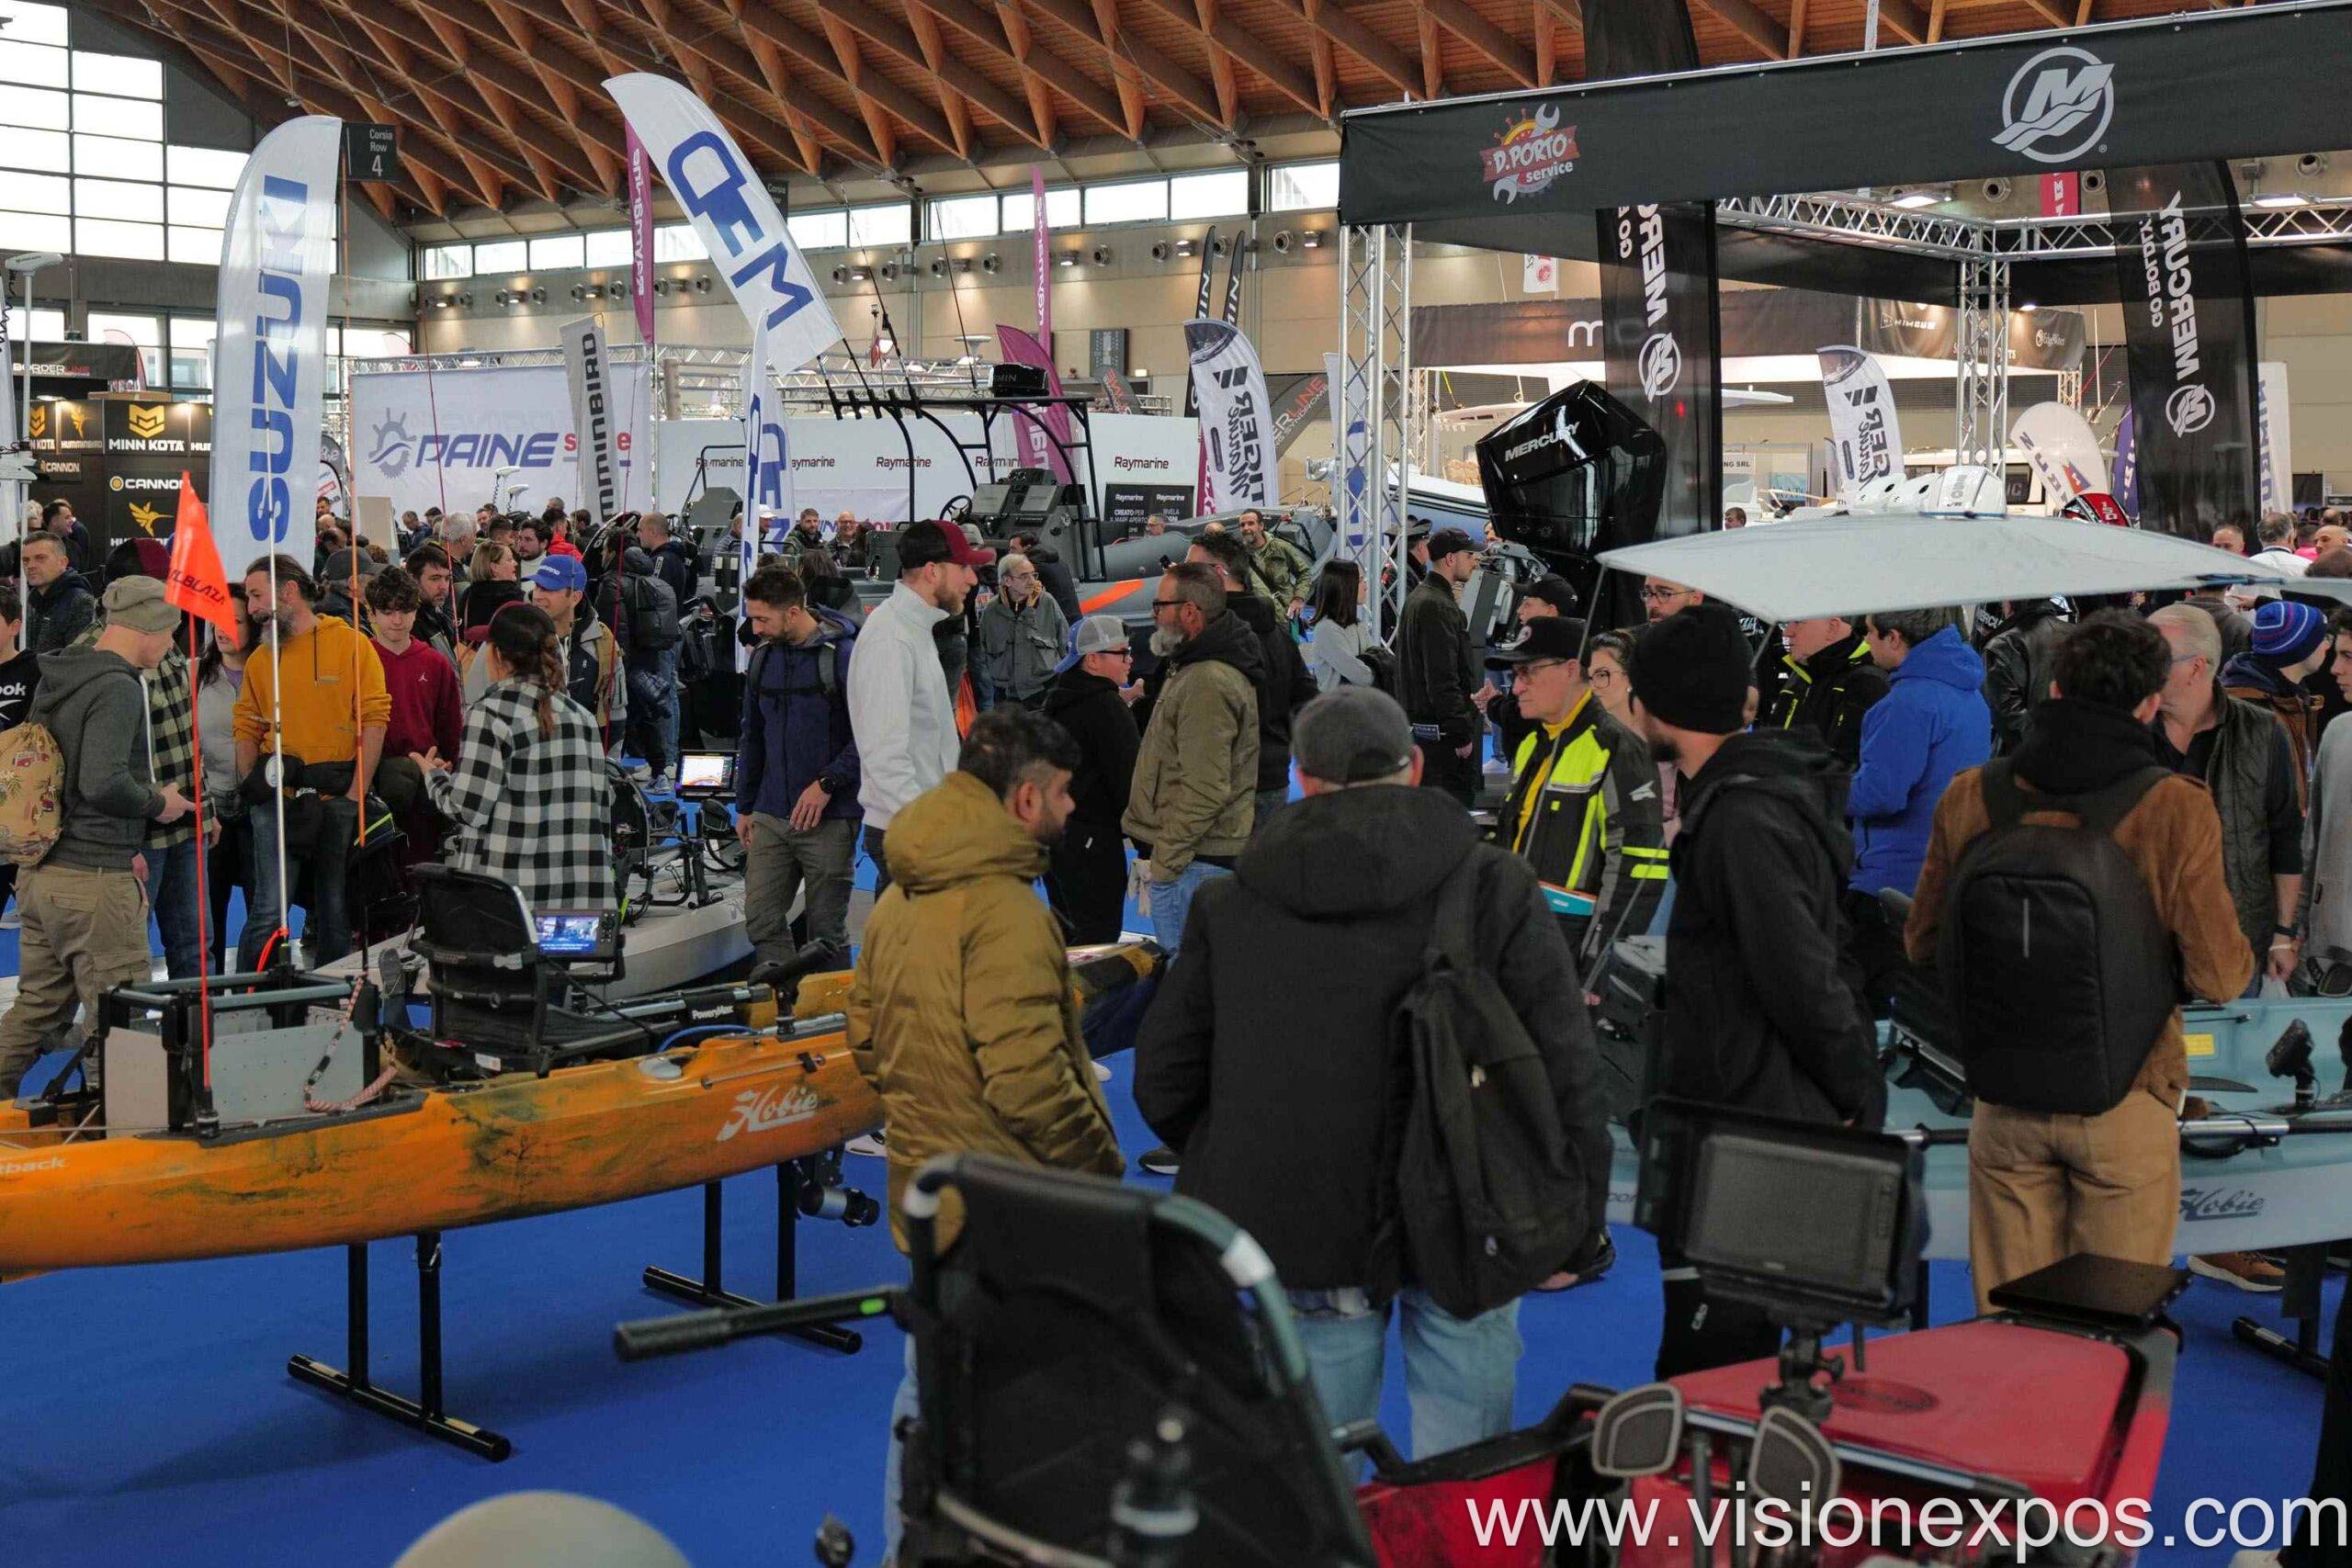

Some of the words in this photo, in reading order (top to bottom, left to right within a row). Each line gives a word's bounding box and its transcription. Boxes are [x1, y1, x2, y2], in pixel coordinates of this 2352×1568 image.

[369, 130, 392, 141] Corsia
[369, 142, 388, 152] Row
[1492, 133, 1567, 174] D.PORTO
[371, 154, 383, 177] 4
[1525, 161, 1574, 184] service
[248, 175, 309, 544] SUZUKI
[108, 439, 145, 450] MINN
[148, 439, 184, 451] KOTA
[415, 433, 559, 468] PAINE
[1505, 423, 1579, 462] MERCURY
[46, 461, 80, 473] CANNON
[791, 456, 835, 469] aymarine
[876, 457, 932, 470] Raymarine
[1114, 457, 1170, 471] Raymarine
[716, 1085, 820, 1143] Hobie
